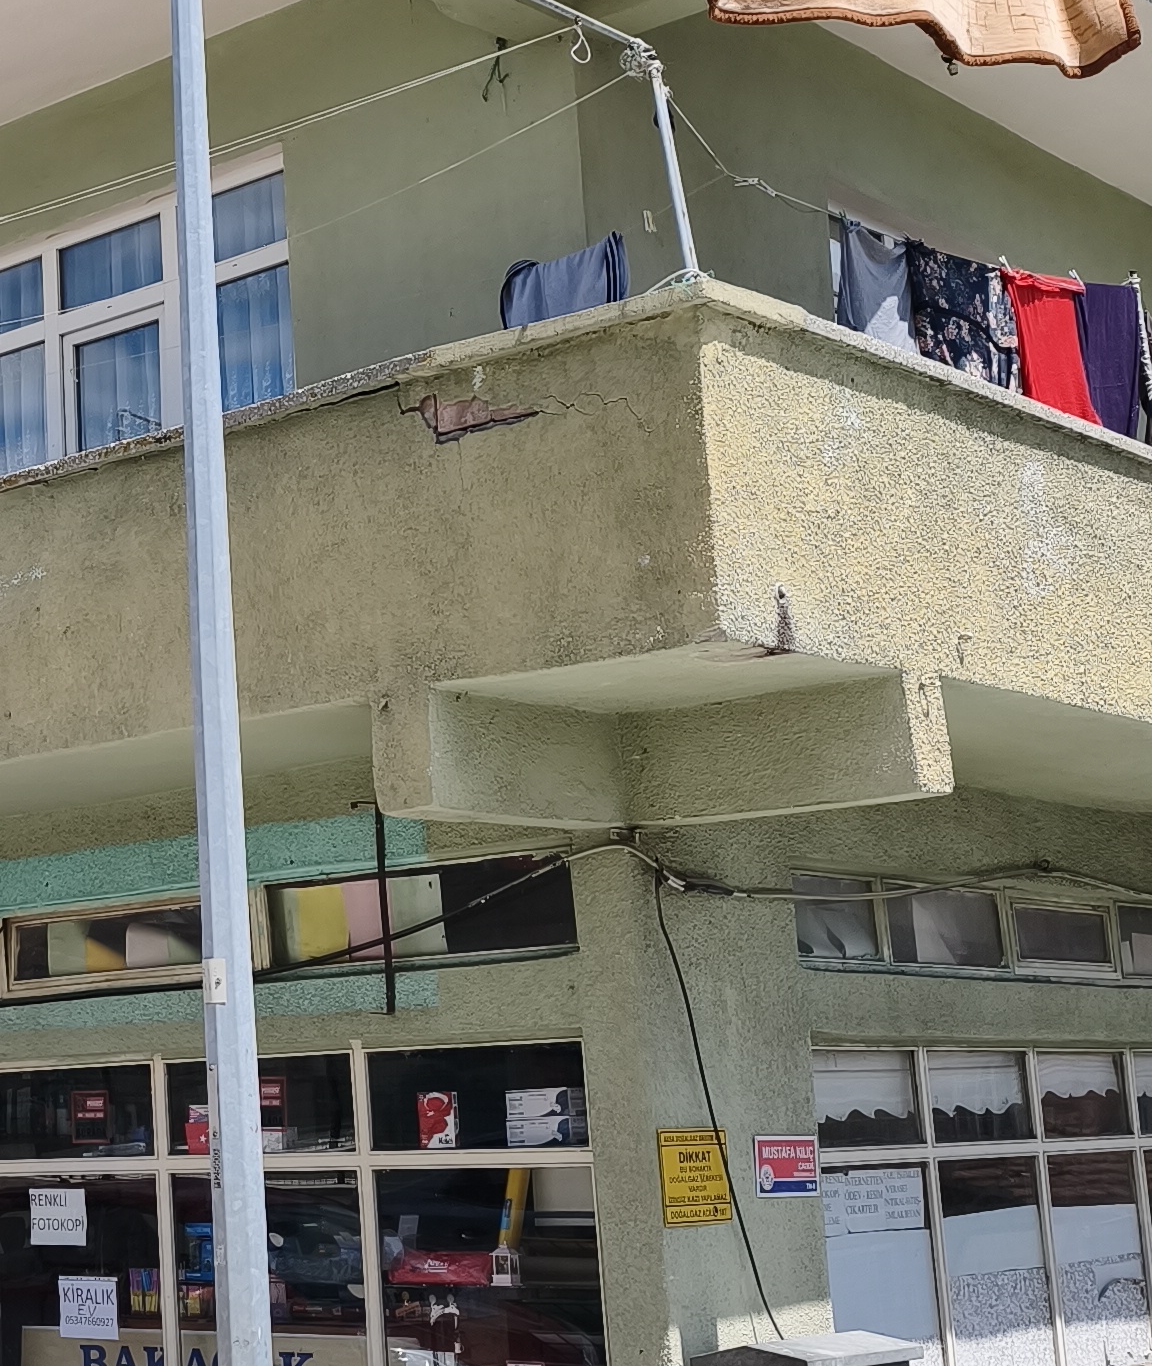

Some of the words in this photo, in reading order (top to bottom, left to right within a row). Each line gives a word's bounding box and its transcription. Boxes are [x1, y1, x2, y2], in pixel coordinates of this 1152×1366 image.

[679, 1148, 711, 1164] DİKKAT
[762, 1146, 796, 1159] MUSTAFA
[31, 1191, 67, 1207] RENKLİ
[32, 1216, 84, 1232] FOTOKOPİ
[62, 1283, 115, 1305] KİRALIK
[77, 1304, 97, 1317] EV
